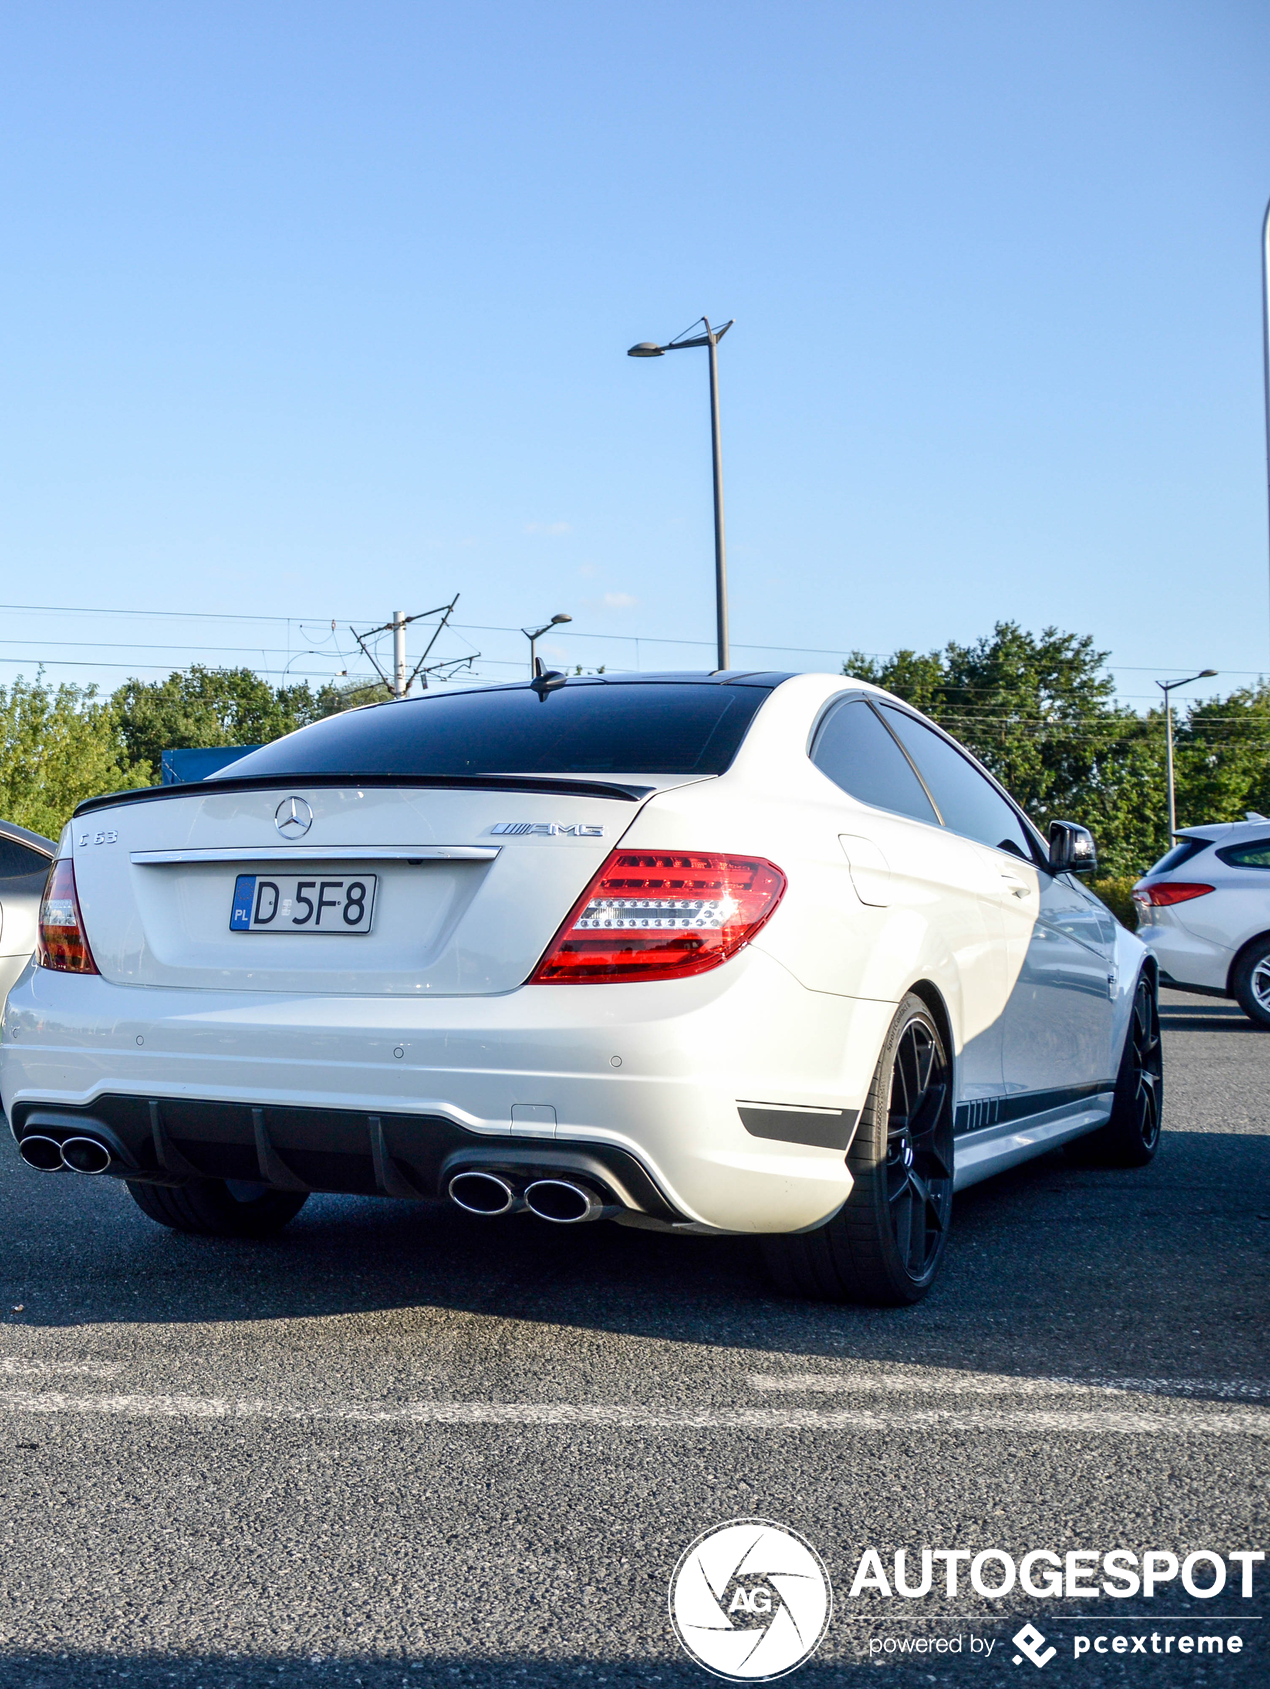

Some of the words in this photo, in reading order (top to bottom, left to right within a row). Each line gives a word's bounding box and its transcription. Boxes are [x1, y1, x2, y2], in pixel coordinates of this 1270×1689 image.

[527, 821, 605, 837] AMG
[79, 833, 89, 847] C
[94, 830, 118, 845] 63
[254, 881, 279, 924] D
[292, 881, 366, 926] 5F8
[234, 909, 248, 921] PL
